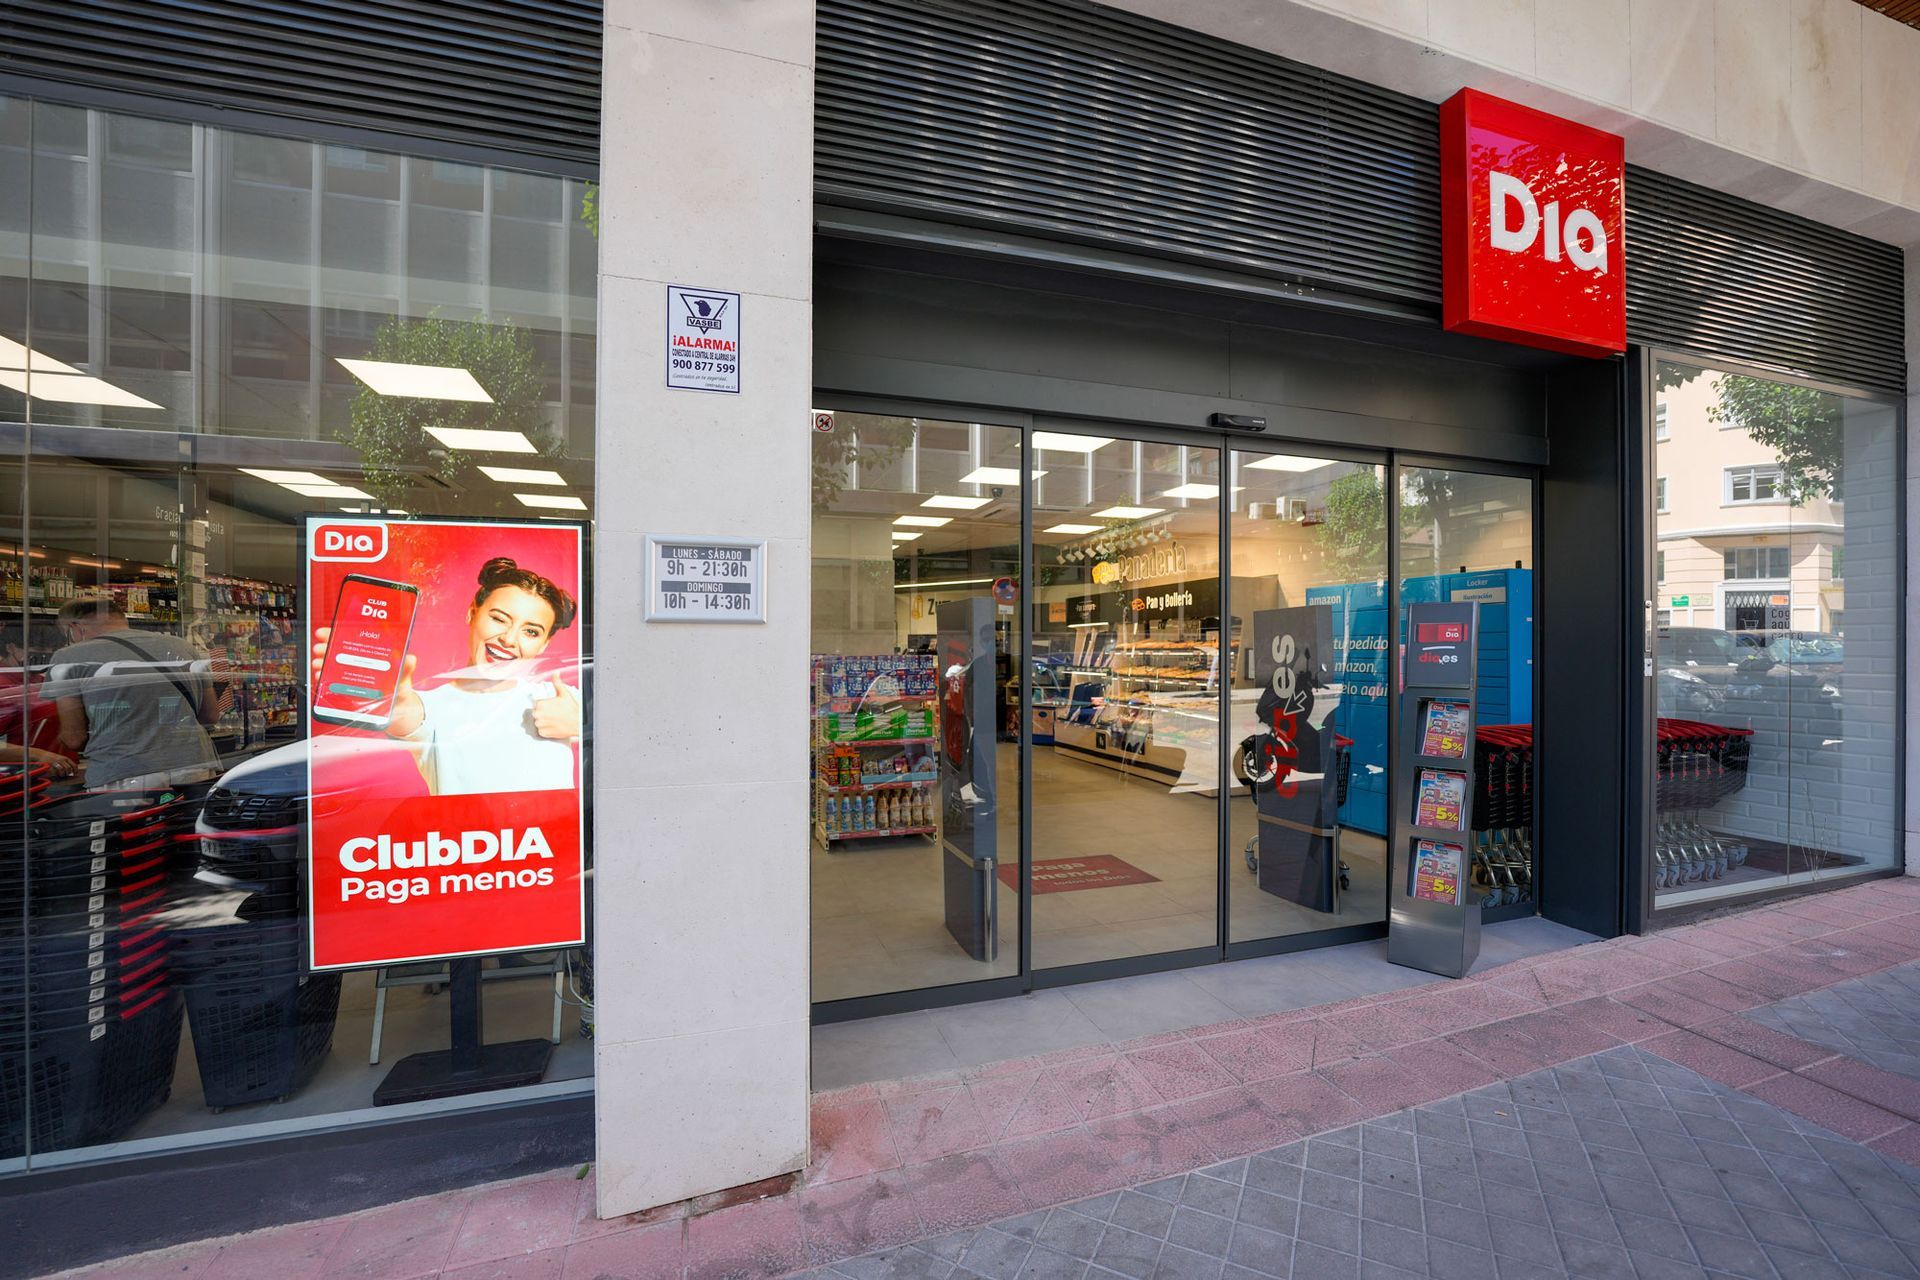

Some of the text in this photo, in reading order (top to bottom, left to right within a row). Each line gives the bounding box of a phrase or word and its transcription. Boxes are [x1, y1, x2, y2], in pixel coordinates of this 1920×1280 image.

[688, 319, 719, 328] VASBE
[673, 335, 736, 352] ¡ALARMA!
[672, 358, 736, 374] 900 877 599
[672, 548, 699, 559] LUNES
[708, 547, 742, 560] SÁBADO
[667, 559, 685, 576] 9h
[702, 560, 747, 578] 21:30h
[1119, 541, 1187, 584] Panadería
[687, 582, 724, 593] DOMINGO
[1466, 579, 1488, 587] Locker
[367, 598, 387, 607] CLUB
[663, 593, 686, 609] 10h
[705, 593, 751, 610] 14:30h
[1146, 590, 1193, 611] Pan y Bollería
[1309, 595, 1341, 606] amazon
[1348, 635, 1389, 650] pedido
[339, 826, 554, 873] ClubDIA
[341, 867, 554, 904] Paga menos
